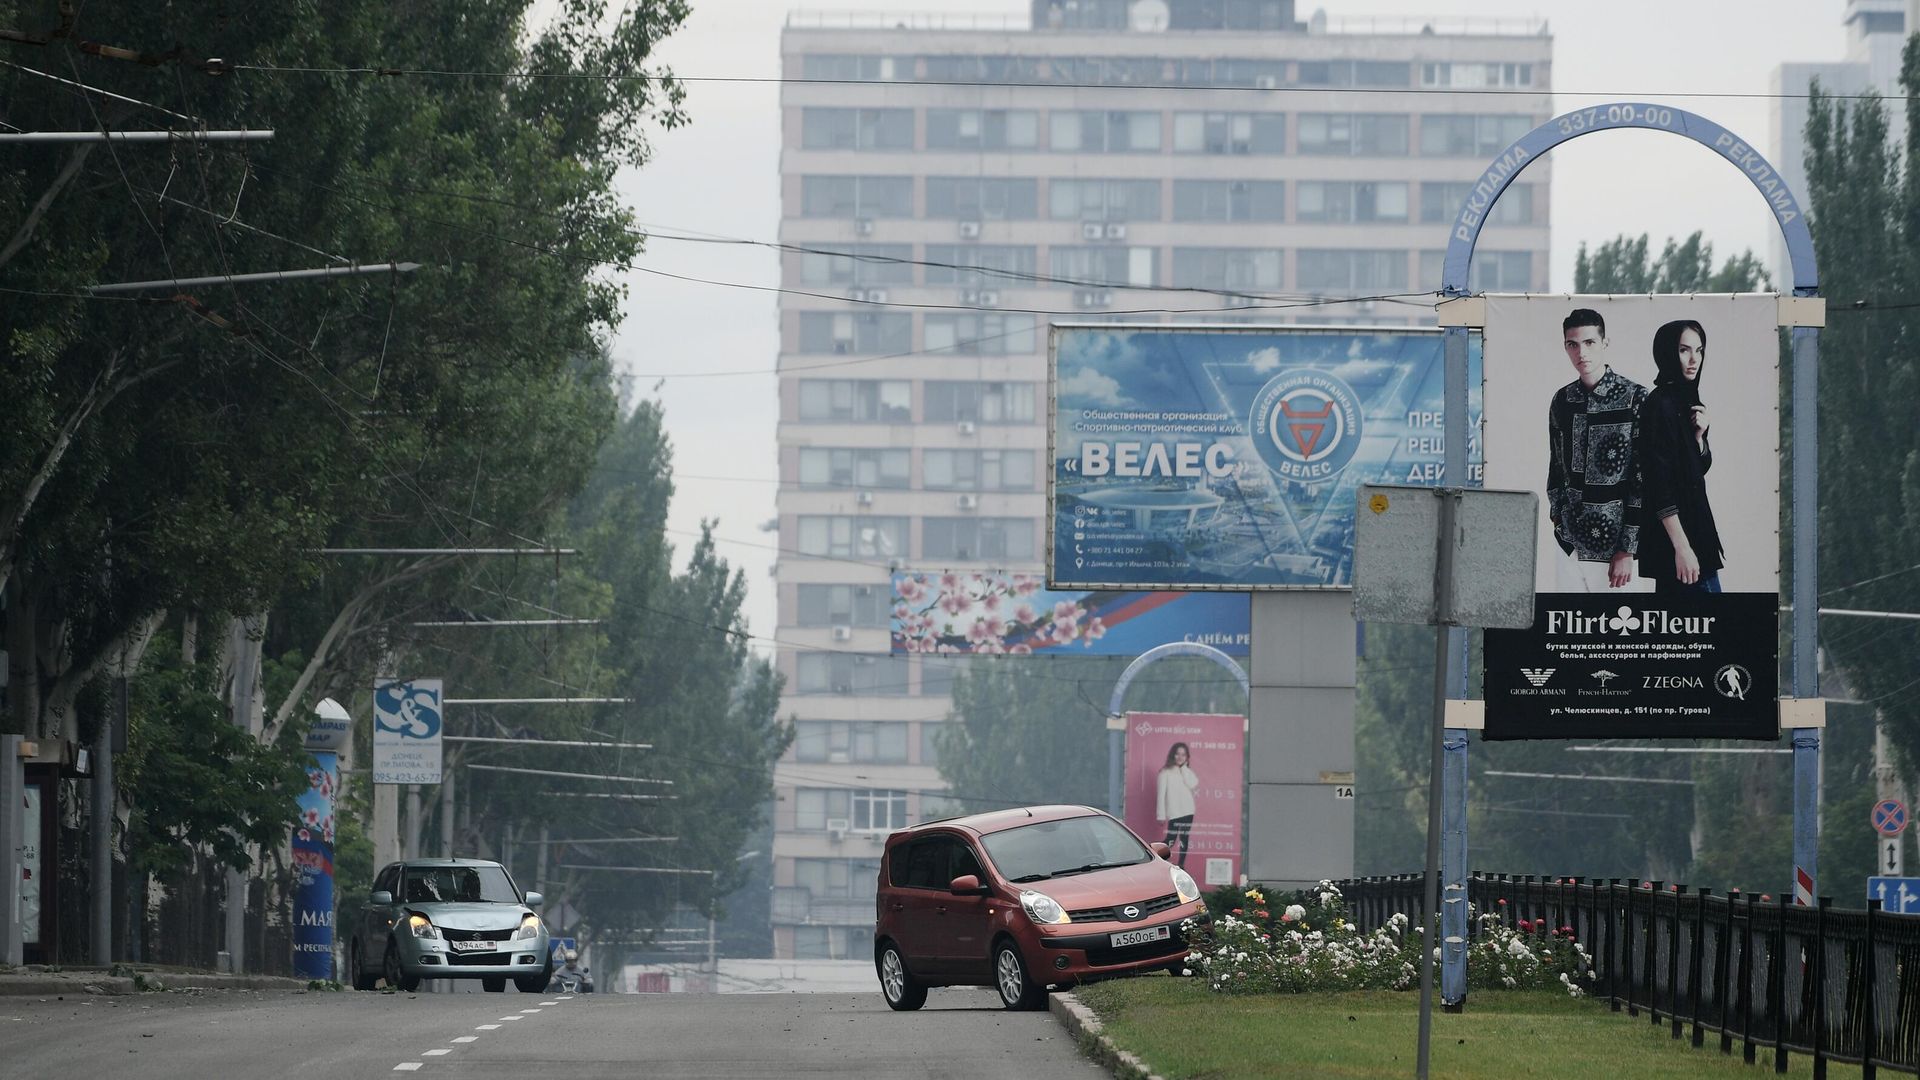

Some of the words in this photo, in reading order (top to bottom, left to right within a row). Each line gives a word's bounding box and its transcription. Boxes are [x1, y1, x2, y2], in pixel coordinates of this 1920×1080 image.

[1558, 105, 1672, 135] 337-00-00
[1716, 132, 1798, 225] РЕКЛАМА
[1455, 145, 1530, 243] РЕКЛАМА
[1257, 376, 1310, 434] ОБЩЕСТВЕННАЯ
[1313, 378, 1355, 436] ОРГАНИЗАЦИЯ
[1082, 410, 1160, 421] Общественная
[1162, 412, 1228, 422] организация
[1074, 421, 1217, 433] Спортивно-патриотический
[1219, 423, 1243, 434] клуб
[1280, 460, 1332, 477] ВЕЛЕС
[1546, 610, 1609, 634] Flirt
[1640, 610, 1715, 634] Fleur
[1546, 642, 1569, 651] бутик
[1571, 642, 1605, 651] мужской
[1615, 642, 1649, 650] женской
[1651, 643, 1686, 651] одежды,
[1688, 642, 1715, 651] обуви,
[1559, 652, 1587, 660] белья,
[1588, 652, 1638, 660] аксессуаров
[1648, 652, 1701, 660] парфюмерии
[1510, 688, 1539, 696] GIORGIO
[1540, 688, 1566, 696] ARMANI
[1642, 676, 1651, 688] Z
[1653, 676, 1704, 689] ZEGNA
[1550, 707, 1562, 715] ул.
[1564, 706, 1622, 715] Челюскинцев,
[1634, 706, 1648, 714] 151
[1649, 706, 1662, 715] (по
[1664, 707, 1677, 715] пр.
[1679, 706, 1711, 715] Гурова)
[1336, 787, 1353, 797] 1А
[1168, 840, 1233, 851] FASHION
[1115, 931, 1155, 946] А560ОЕ
